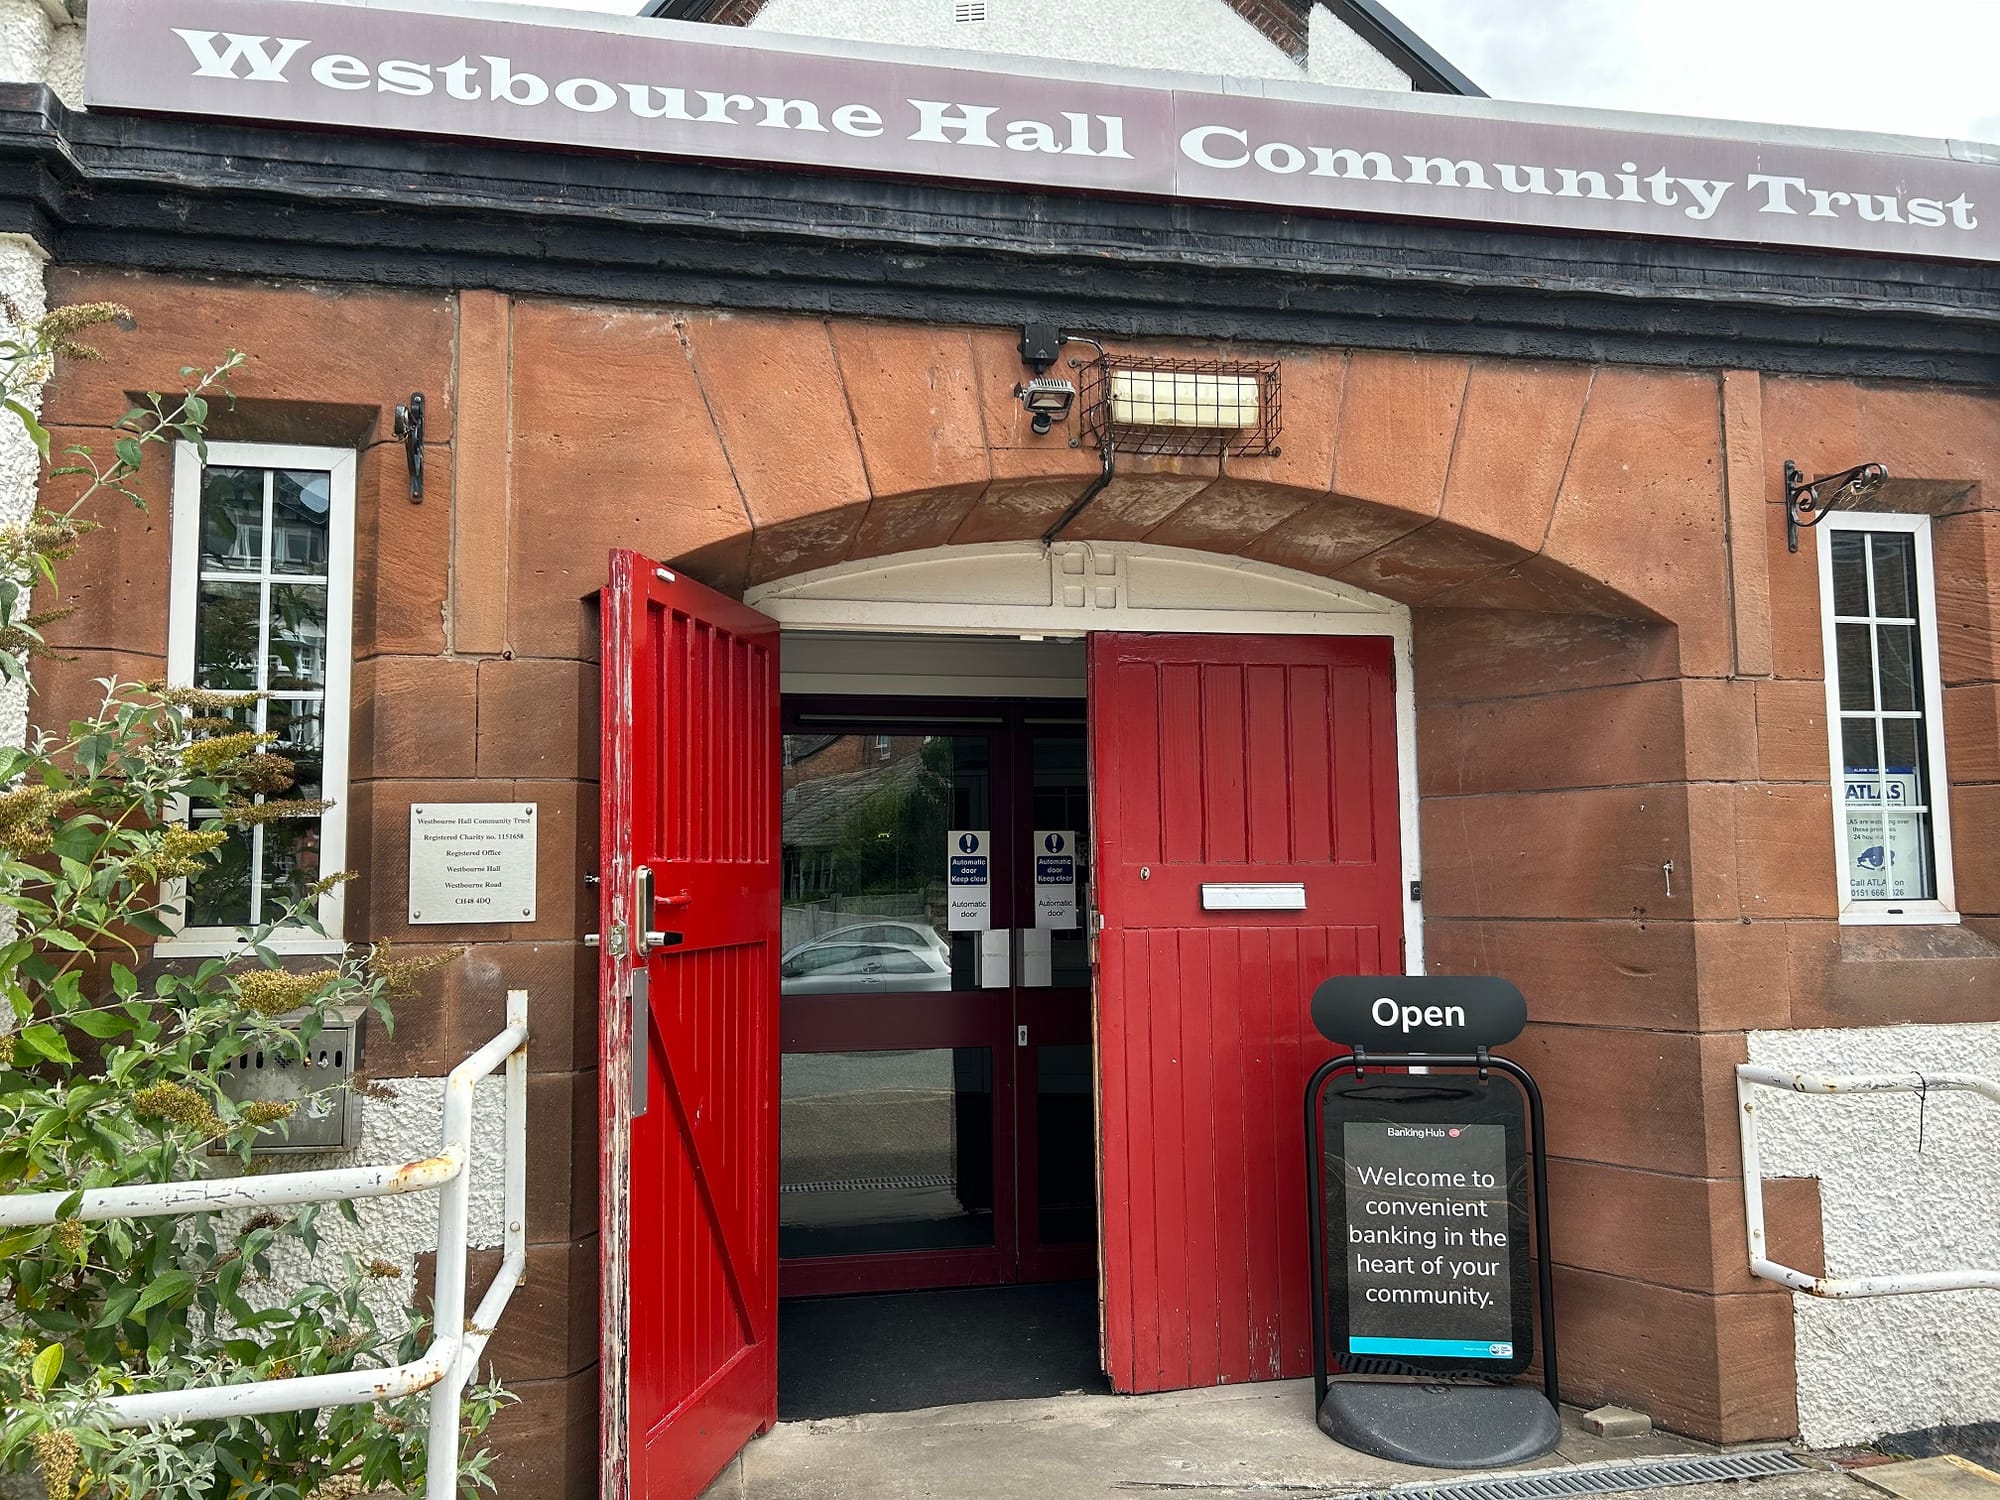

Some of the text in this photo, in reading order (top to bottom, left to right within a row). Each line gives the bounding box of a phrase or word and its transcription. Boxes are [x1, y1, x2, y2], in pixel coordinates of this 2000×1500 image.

[171, 28, 1978, 231] Westbourne Hall Community Trust
[459, 833, 484, 841] Charity
[952, 858, 986, 866] Automatic
[951, 875, 968, 883] Keep
[1851, 889, 1869, 897] 0151
[952, 900, 987, 908] Automatic
[960, 910, 977, 918] door
[1047, 909, 1064, 917] door
[1372, 997, 1465, 1033] Open
[1357, 1166, 1495, 1188] Welcome to
[1365, 1198, 1488, 1217] convenient
[1349, 1224, 1507, 1249] banking in the
[1357, 1254, 1500, 1279] heart of your
[1365, 1286, 1494, 1309] community.
